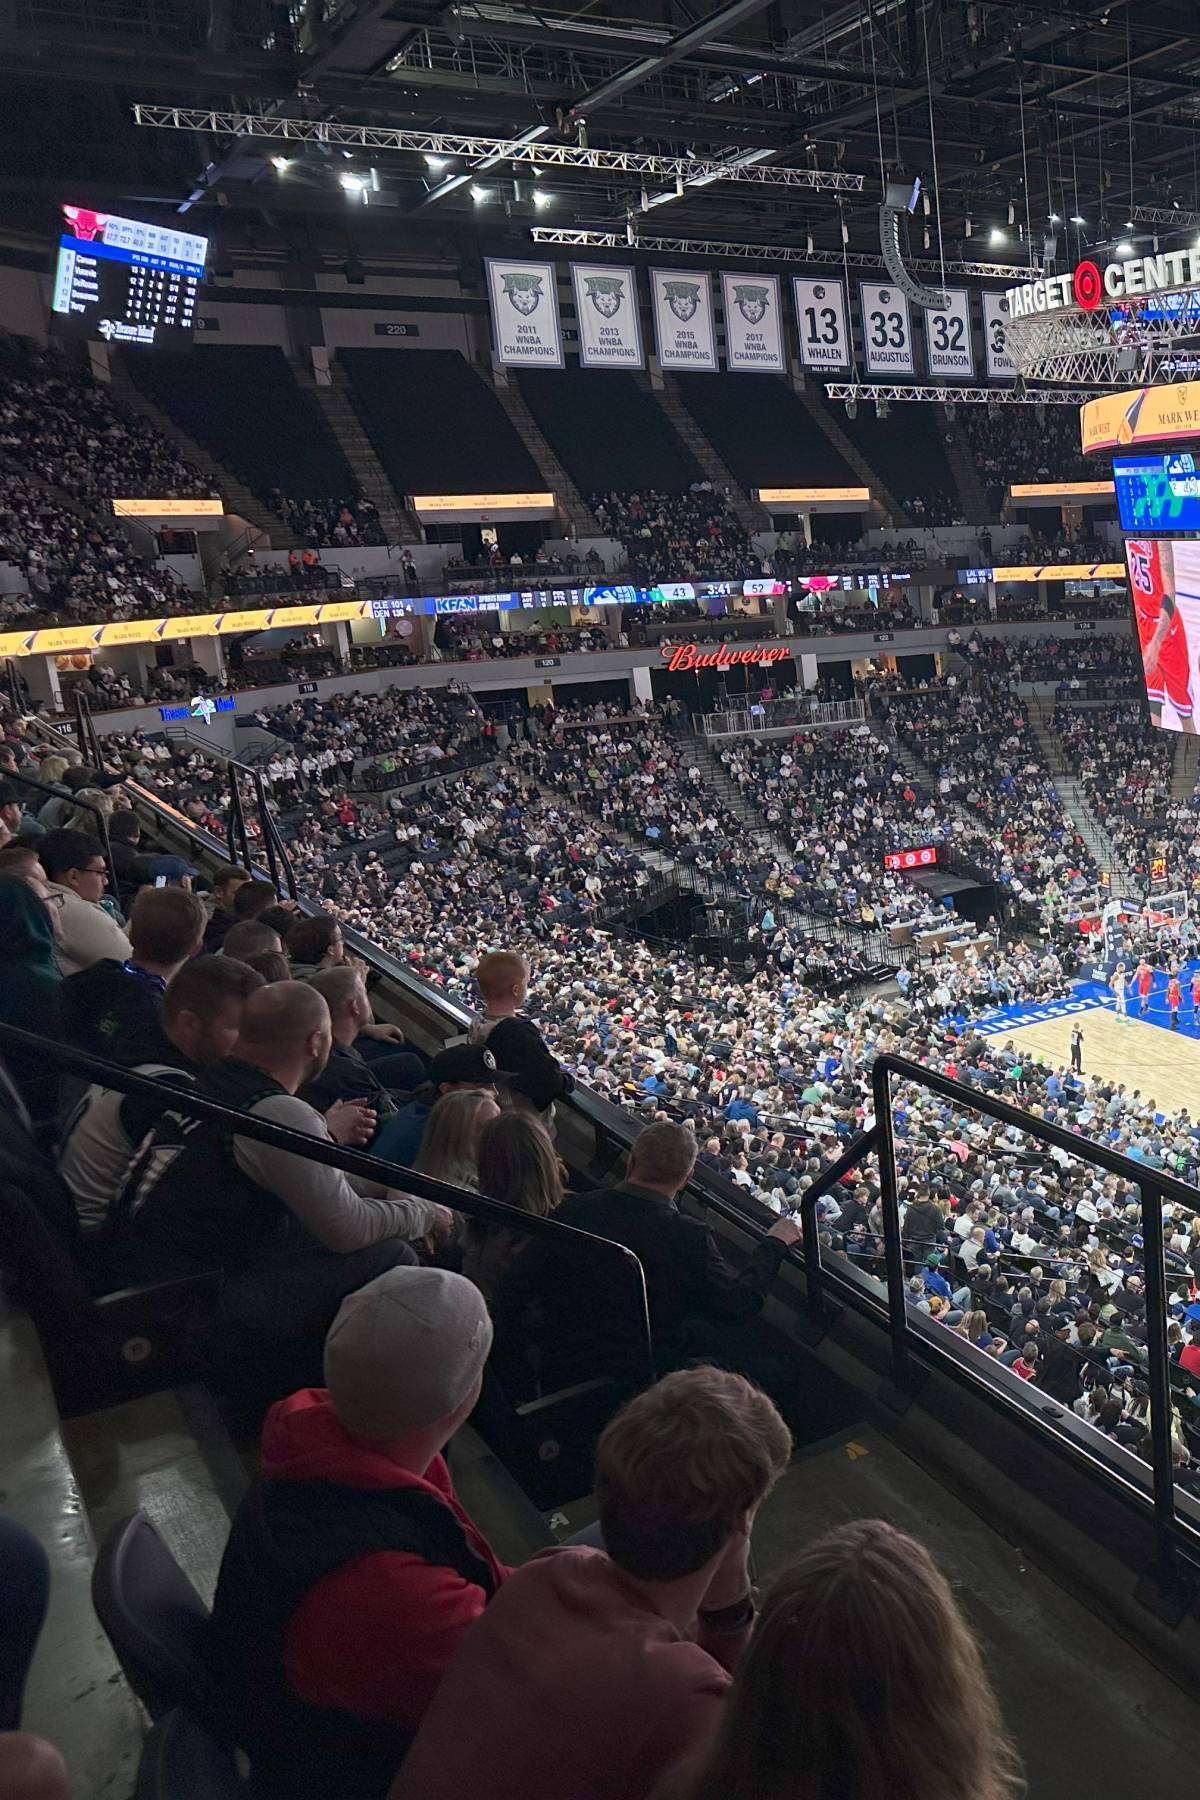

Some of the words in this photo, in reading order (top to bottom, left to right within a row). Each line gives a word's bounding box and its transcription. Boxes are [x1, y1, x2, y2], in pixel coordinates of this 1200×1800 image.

[1005, 272, 1075, 319] TARGET
[386, 325, 407, 335] 220
[517, 325, 537, 335] 2011
[600, 327, 620, 336] 2013
[805, 307, 839, 345] 13
[870, 311, 905, 348] 33
[676, 330, 695, 340] 2015
[746, 333, 763, 341] 2017
[932, 315, 966, 351] 32
[515, 335, 542, 345] WNBA
[598, 337, 624, 346] WNBA
[674, 340, 698, 349] WNBA
[504, 345, 555, 356] CHAMPIONS
[744, 342, 767, 351] WNBA
[587, 347, 636, 358] CHAMPIONS
[664, 349, 711, 360] CHAMPIONS
[734, 351, 778, 362] CHAMPIONS
[808, 348, 842, 360] WHALEN
[870, 351, 910, 363] AUGUSTUS
[932, 354, 970, 366] BRUNSON
[1158, 412, 1183, 426] MARK
[1130, 550, 1154, 594] 25
[672, 588, 686, 598] 43
[707, 584, 731, 595] 3:41
[752, 584, 764, 593] 52
[372, 601, 389, 609] CLE
[405, 604, 412, 612] 4
[437, 598, 477, 612] KFAN
[374, 610, 390, 618] DEN
[661, 643, 790, 672] Budweiser
[1151, 867, 1165, 880] 24
